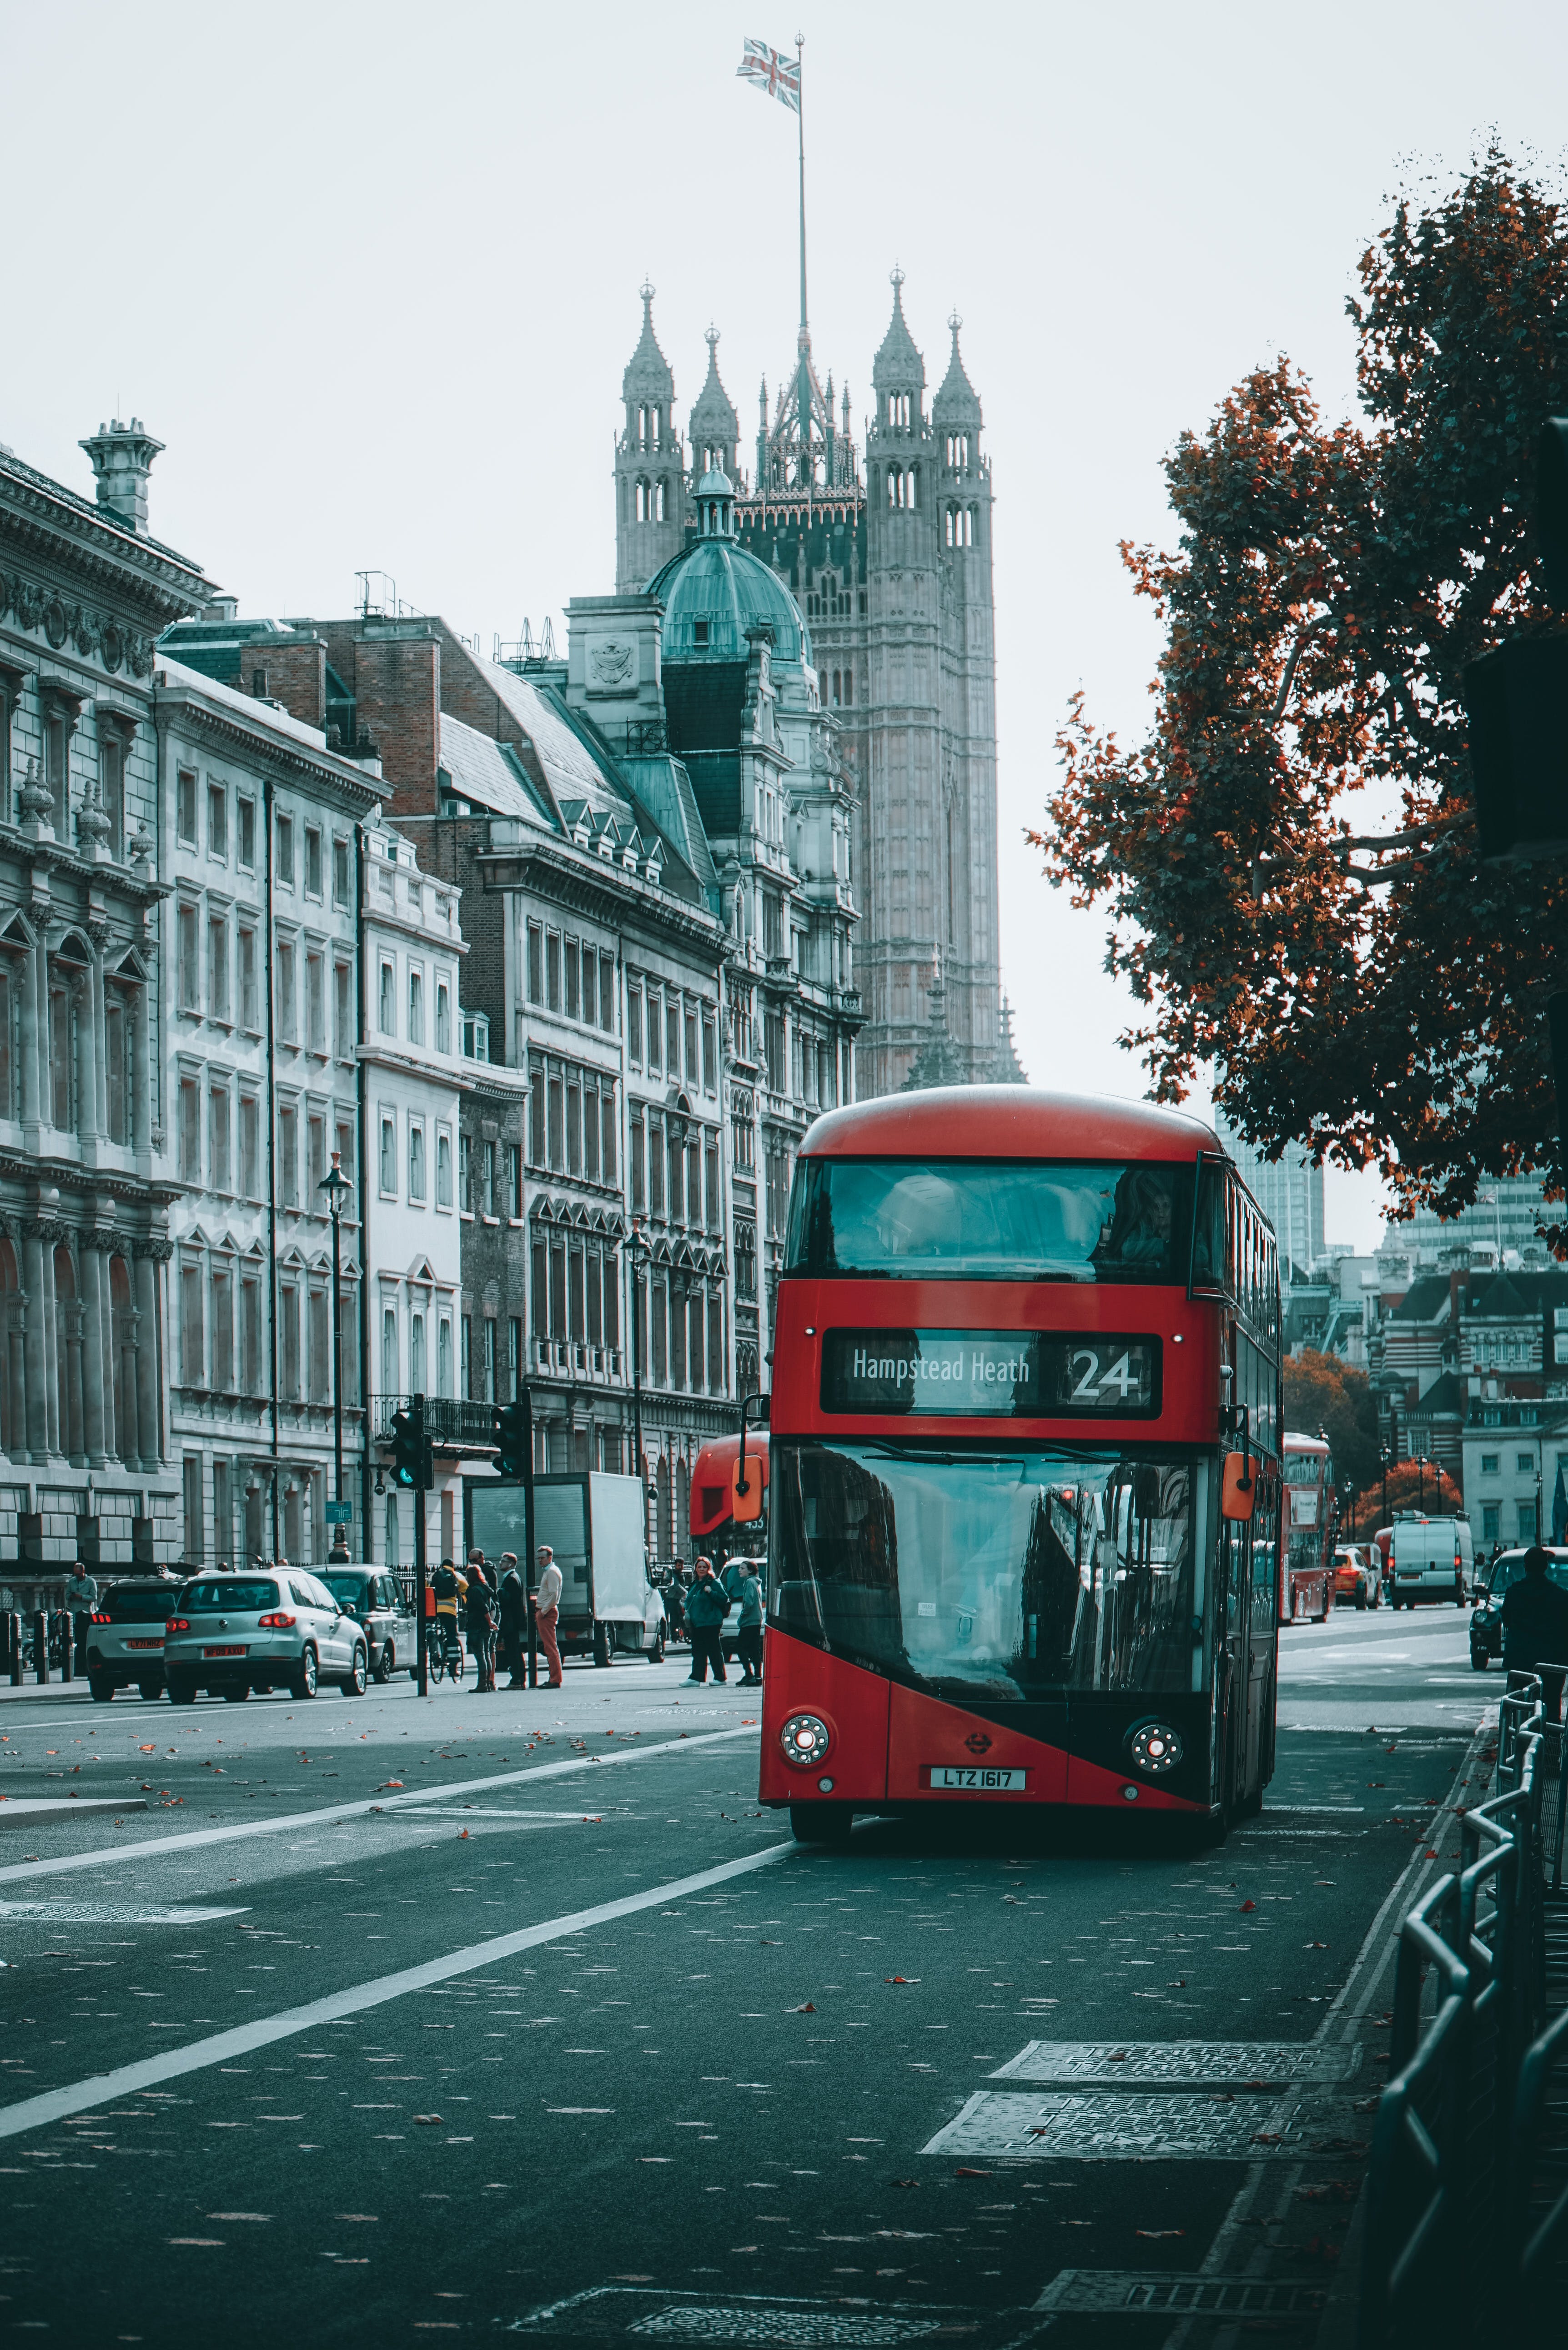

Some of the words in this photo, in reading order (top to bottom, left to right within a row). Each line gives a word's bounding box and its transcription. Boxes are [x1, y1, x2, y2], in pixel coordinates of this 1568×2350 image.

[853, 1349, 964, 1388] Hampstead
[971, 1352, 1029, 1382] Heath
[1071, 1349, 1138, 1397] 24
[944, 1770, 976, 1786] LTZ
[981, 1771, 1012, 1787] 1617
